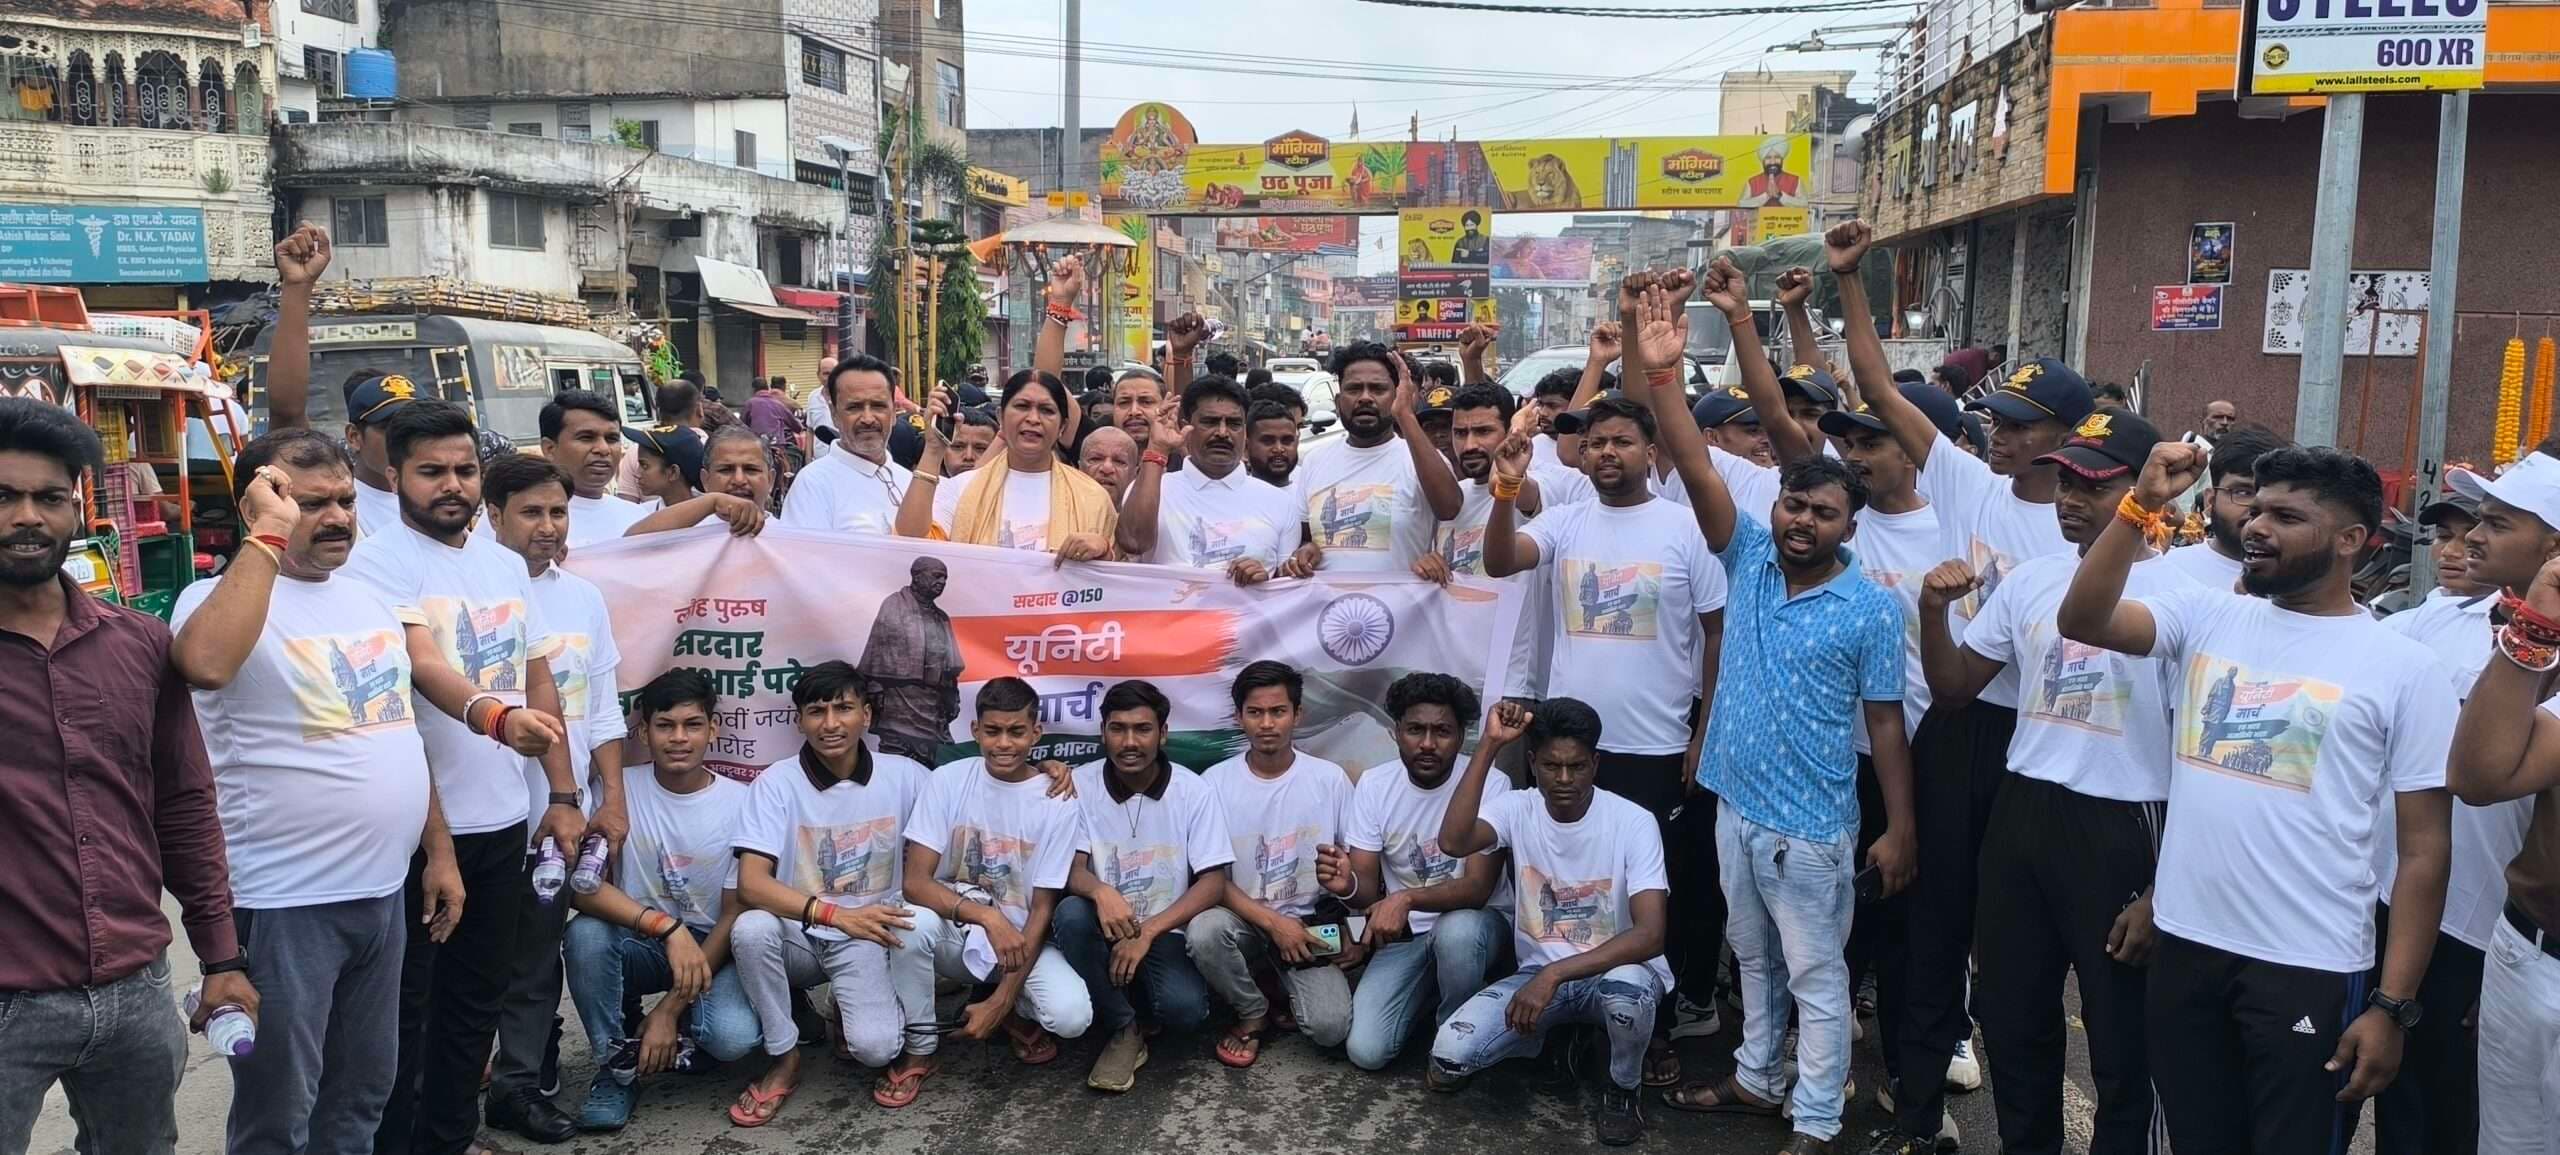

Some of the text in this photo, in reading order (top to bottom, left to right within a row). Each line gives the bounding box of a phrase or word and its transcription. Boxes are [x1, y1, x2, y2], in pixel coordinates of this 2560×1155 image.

[2377, 38, 2474, 67] 600 XR
[2315, 74, 2421, 86] www.lallsteels.com
[1261, 176, 1334, 195] छठ पूजा
[117, 231, 195, 242] Dr. N.K. YADAV
[1415, 328, 1452, 339] TRAFFIC
[1013, 587, 1104, 609] सरदार @150
[714, 598, 767, 624] पुरुष
[1004, 621, 1126, 674] यूनिटी
[2235, 704, 2266, 719] मार्च
